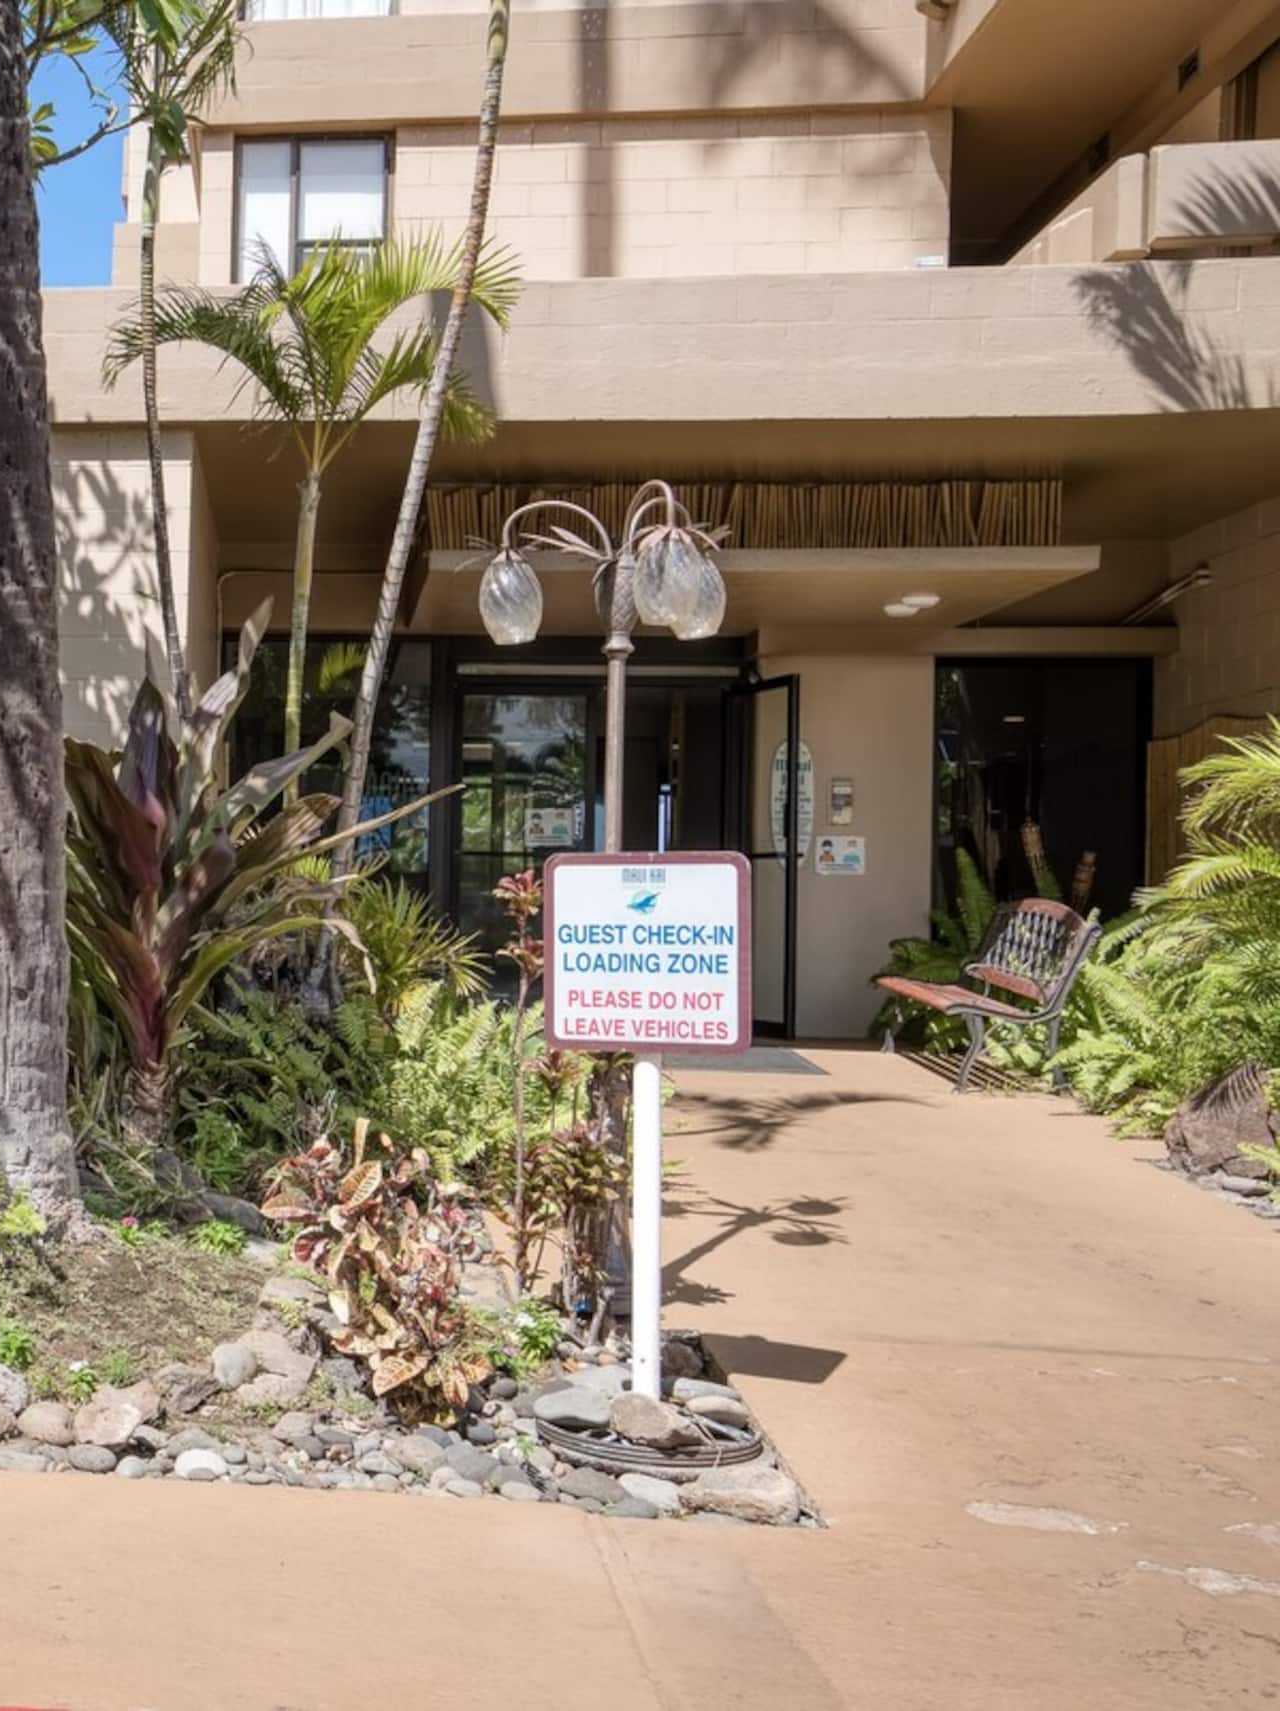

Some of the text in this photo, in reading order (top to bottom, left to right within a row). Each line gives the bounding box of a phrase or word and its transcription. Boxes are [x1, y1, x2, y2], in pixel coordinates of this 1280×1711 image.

[558, 924, 734, 945] GUEST CHECK-IN
[563, 952, 729, 974] LOADING ZONE
[567, 990, 724, 1010] PLEASE DO NOT
[564, 1018, 728, 1040] LEAVE VEHICLES
